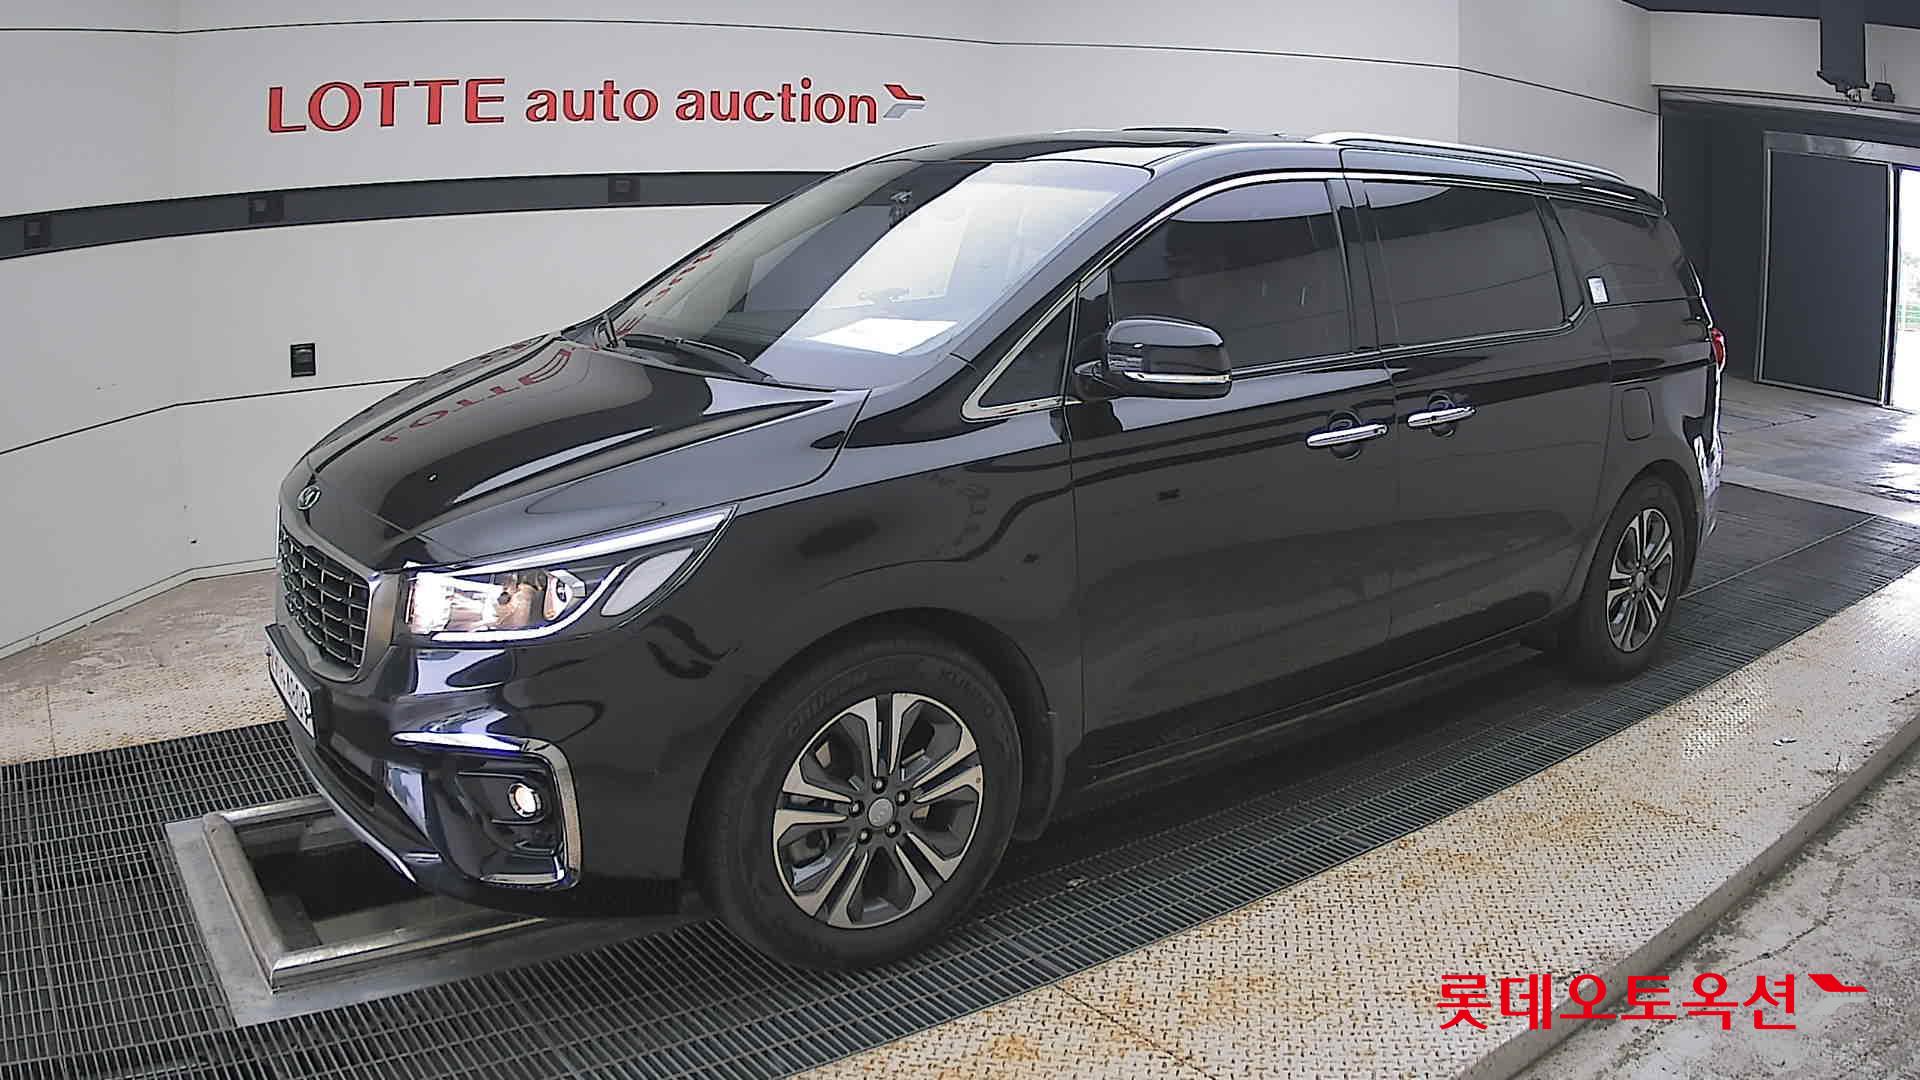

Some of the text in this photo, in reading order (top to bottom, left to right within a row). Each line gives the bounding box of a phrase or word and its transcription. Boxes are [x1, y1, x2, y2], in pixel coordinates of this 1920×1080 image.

[267, 78, 879, 133] LOTTE auto auction
